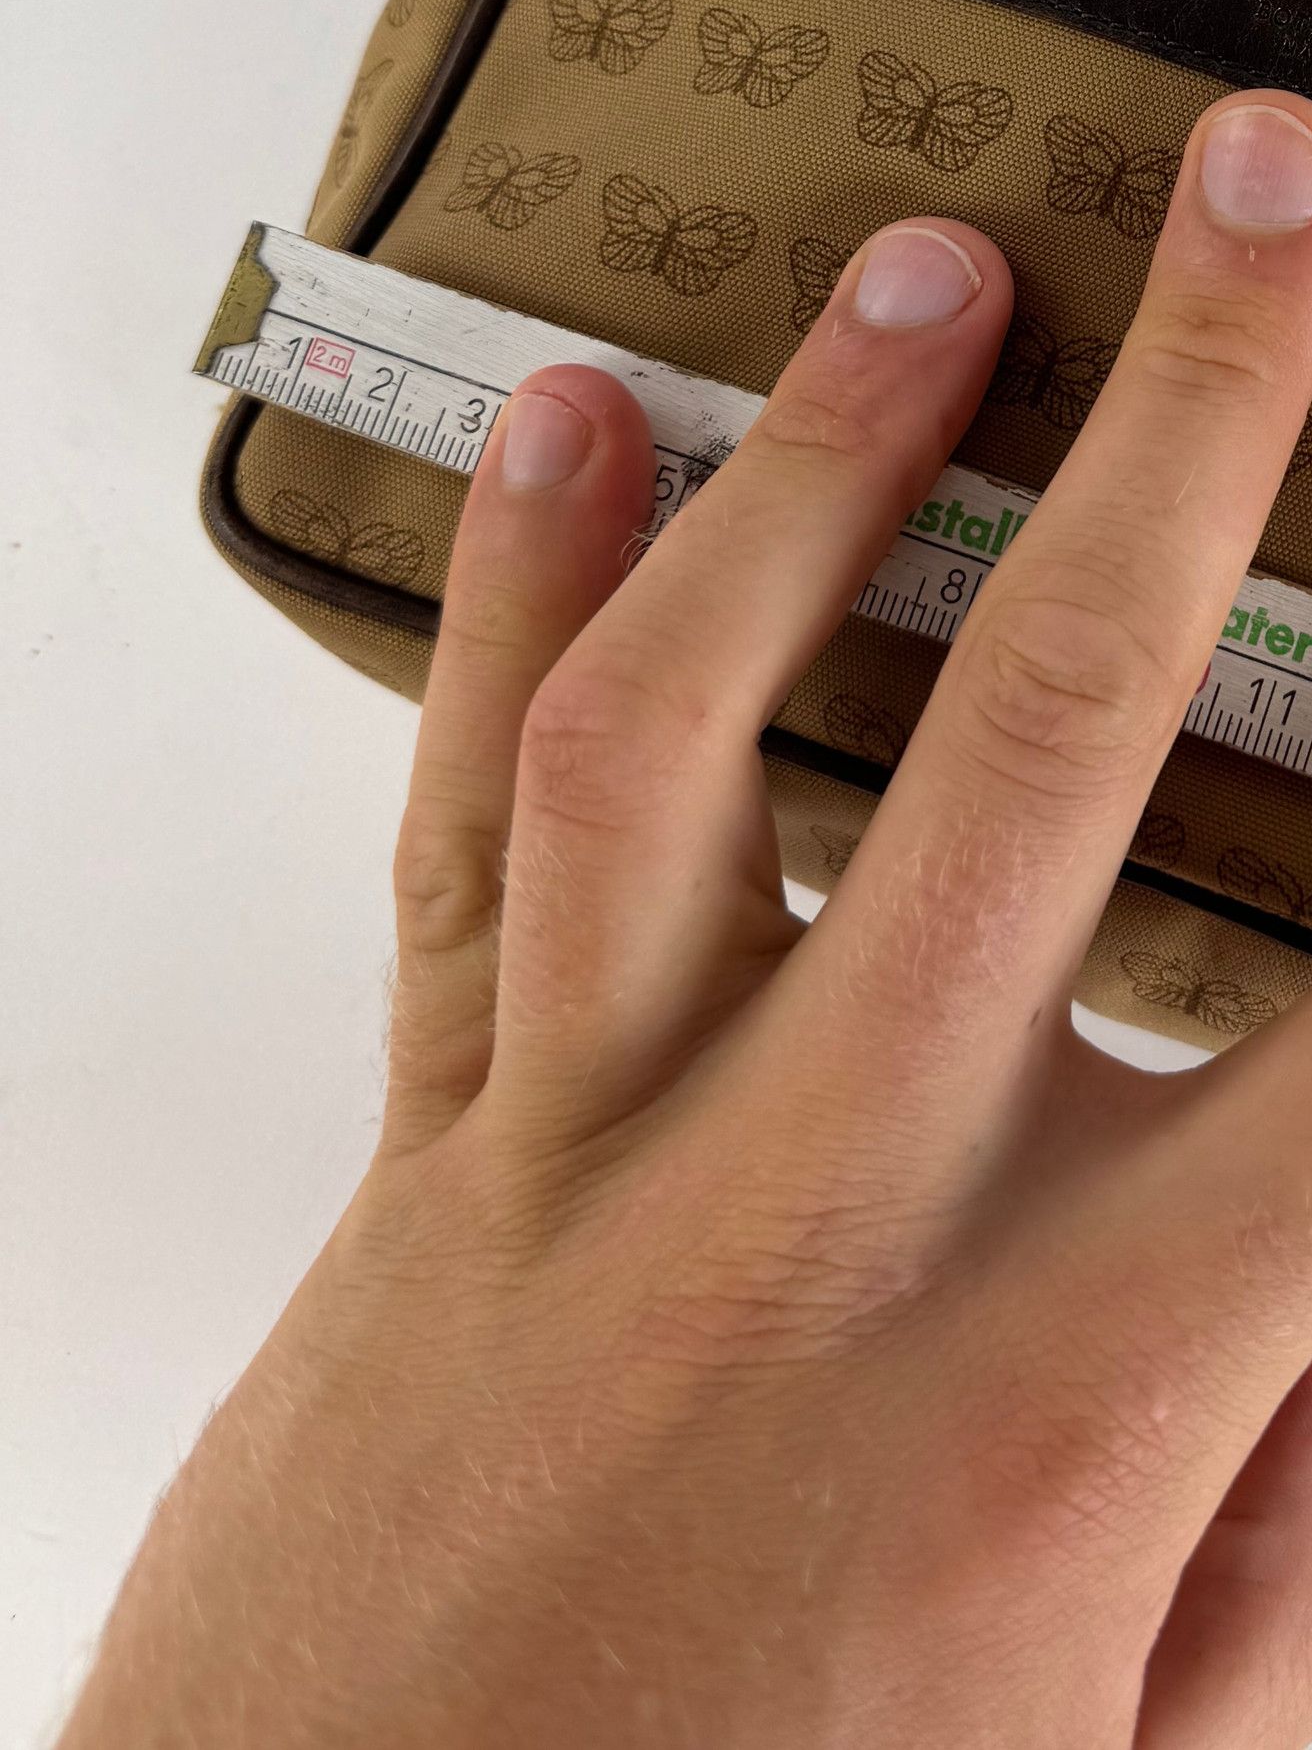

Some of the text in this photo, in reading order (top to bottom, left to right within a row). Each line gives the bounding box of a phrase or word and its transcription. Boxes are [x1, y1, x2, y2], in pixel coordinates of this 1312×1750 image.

[288, 336, 303, 370] 1
[366, 366, 395, 403] 2
[459, 397, 487, 434] 3
[655, 463, 678, 502] 5
[940, 568, 967, 605] 8
[1249, 677, 1299, 727] 11
